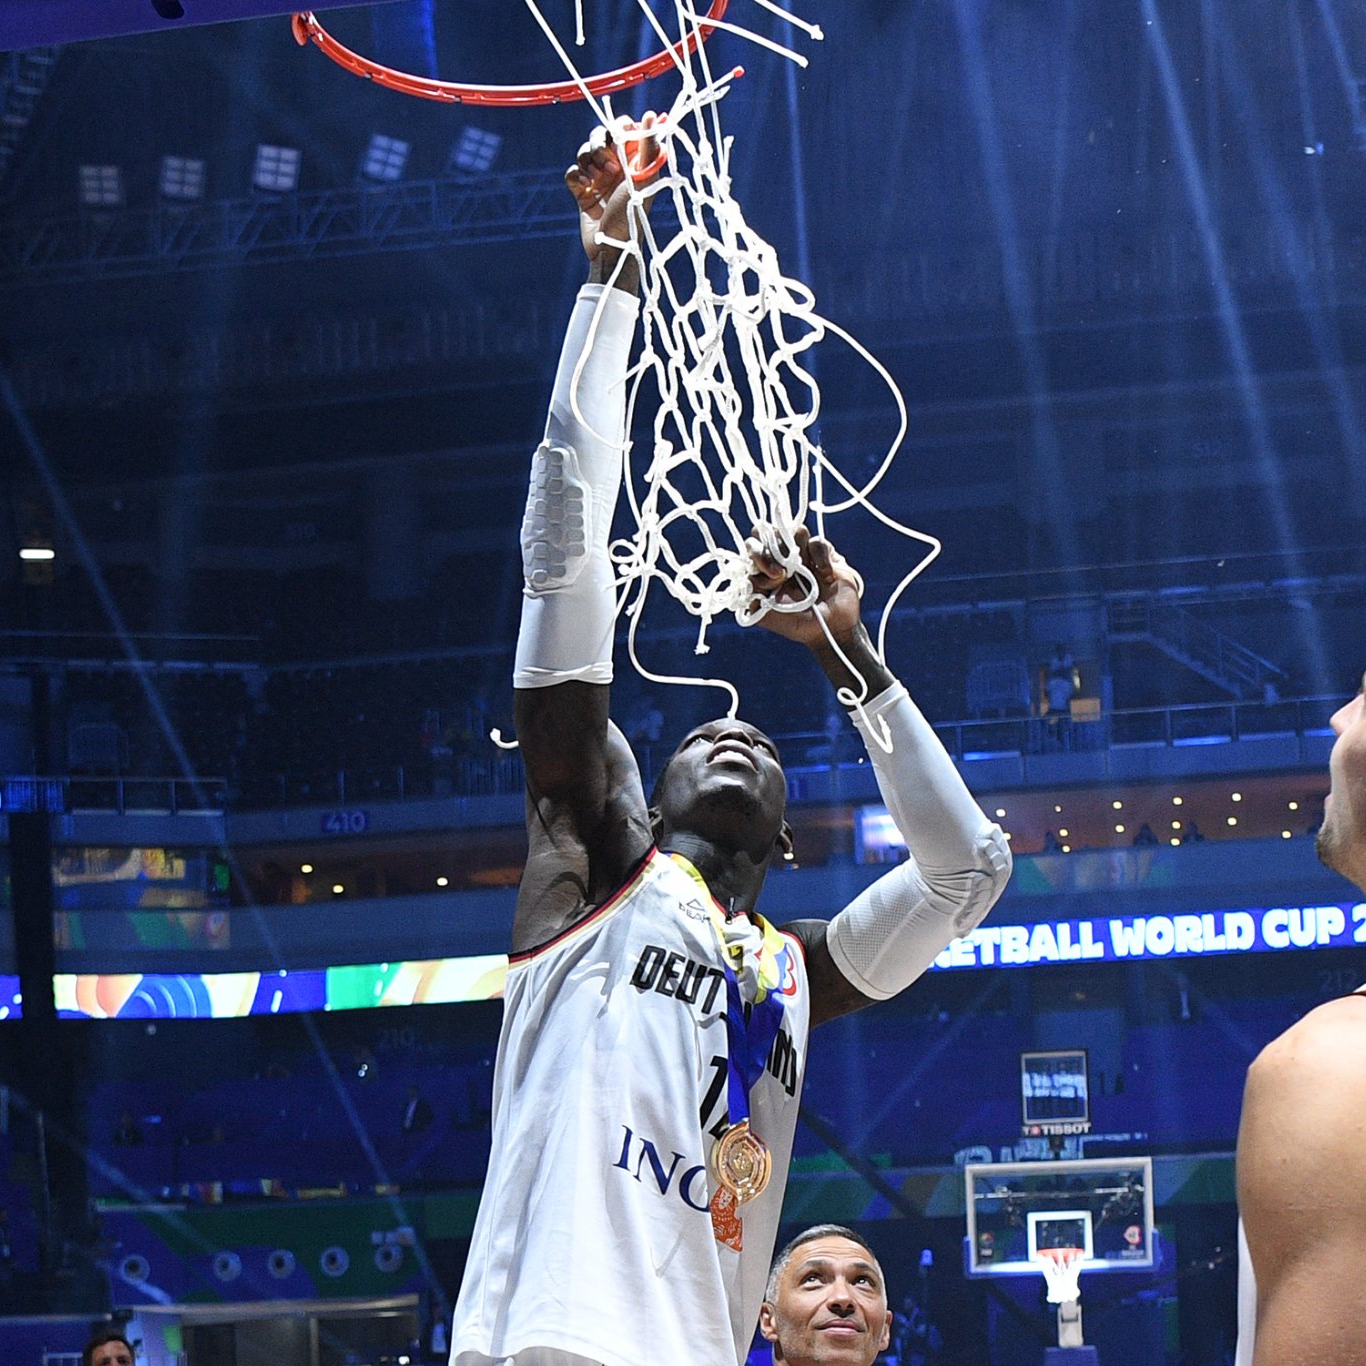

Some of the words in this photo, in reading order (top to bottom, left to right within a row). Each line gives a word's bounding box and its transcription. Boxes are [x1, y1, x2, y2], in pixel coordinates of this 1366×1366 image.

[326, 811, 365, 832] 410
[1111, 911, 1255, 957] WORLD
[1262, 907, 1345, 949] CUP
[629, 944, 797, 1097] DEUTND
[1043, 1122, 1091, 1136] TISSOT
